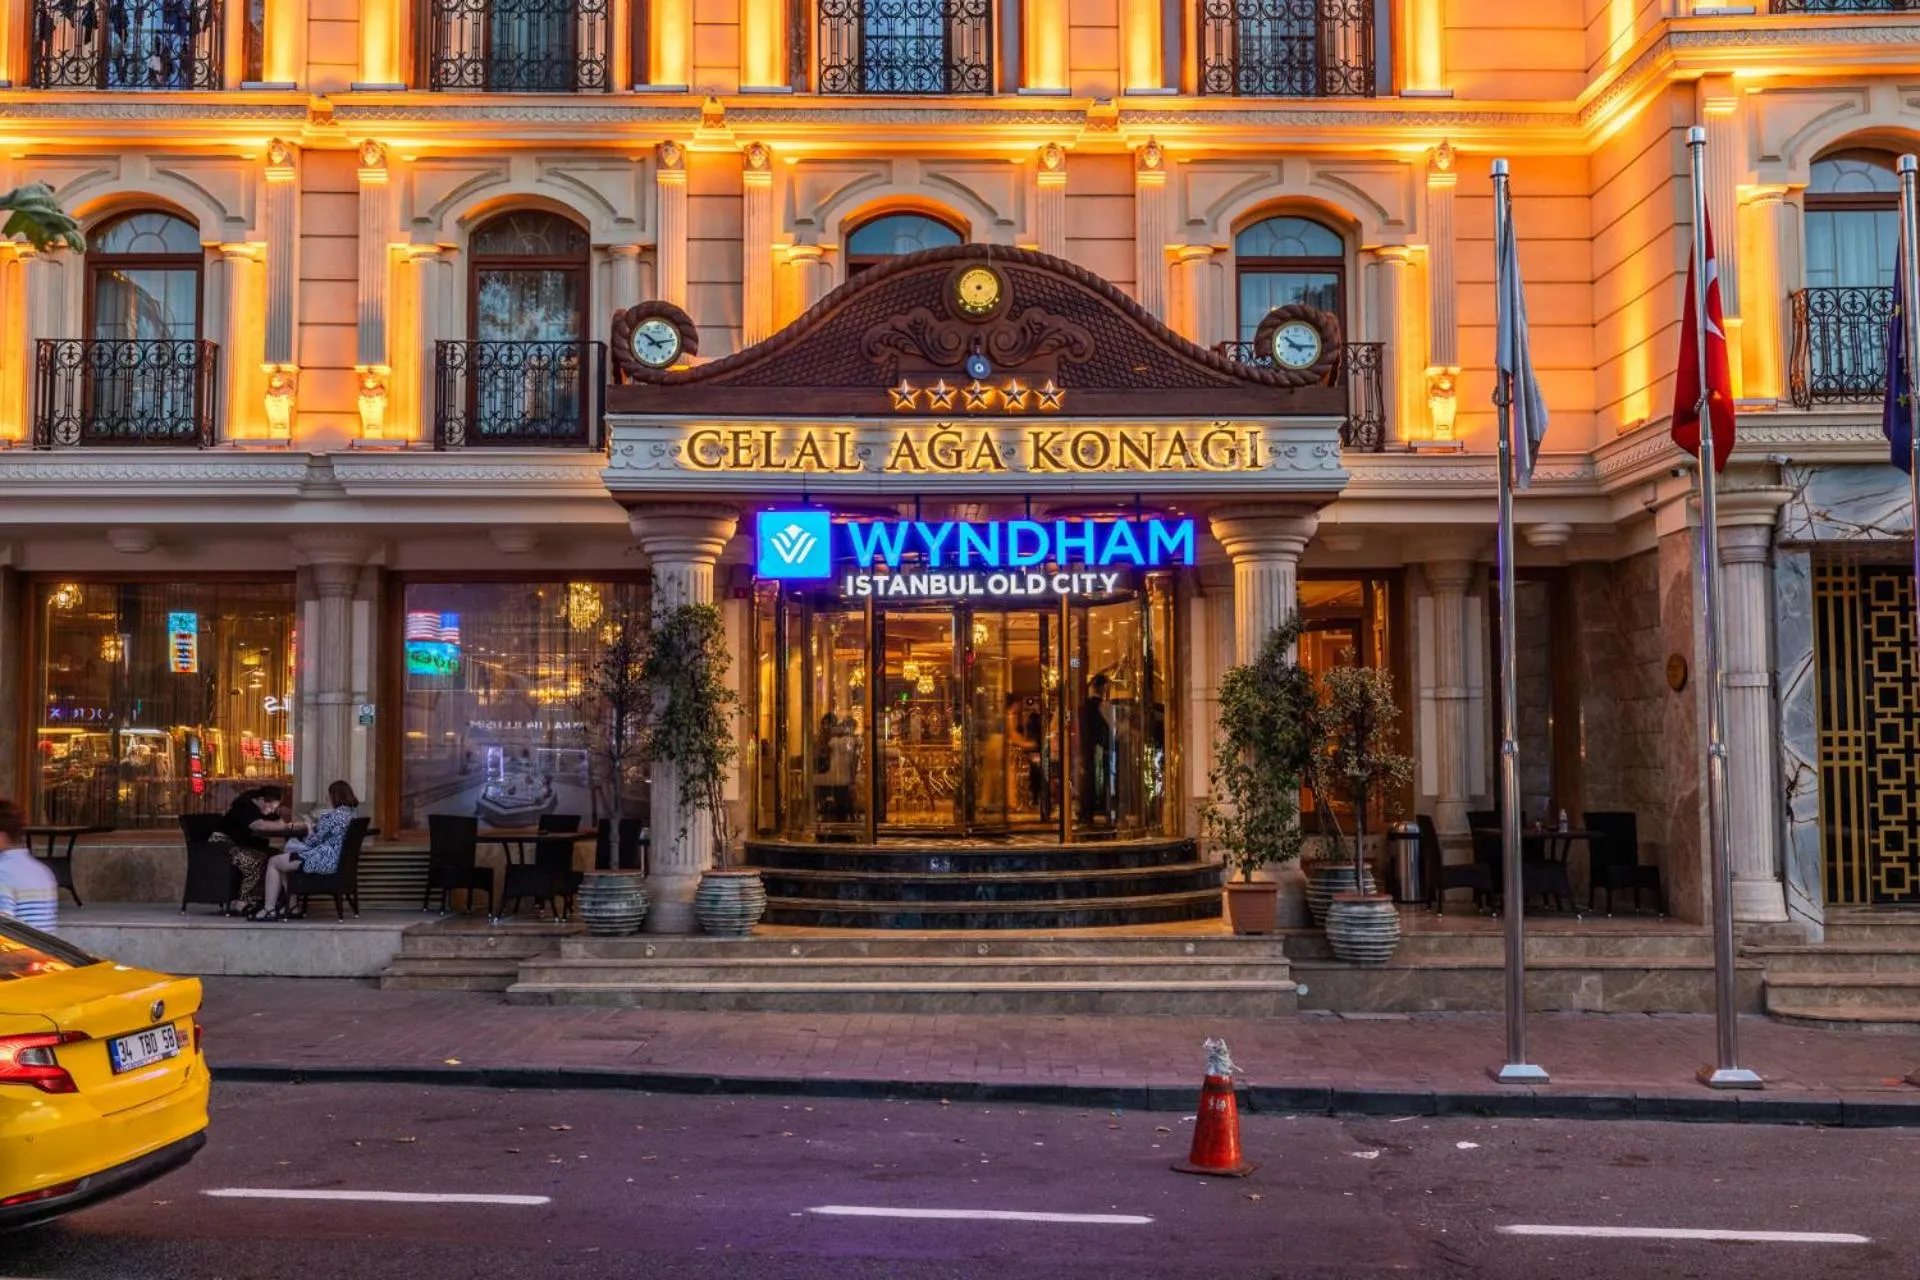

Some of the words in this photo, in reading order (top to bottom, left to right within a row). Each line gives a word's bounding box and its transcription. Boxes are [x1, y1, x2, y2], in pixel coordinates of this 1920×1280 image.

[687, 429, 862, 471] CELAL
[886, 422, 1006, 471] AĞA
[1028, 421, 1264, 471] KONAĞI
[847, 519, 1195, 567] WYNDHAM
[846, 574, 984, 596] ISTANBUL
[987, 573, 1047, 595] OLD
[1052, 572, 1119, 594] CITY
[118, 1040, 133, 1062] 34
[138, 1033, 158, 1056] TBD
[161, 1027, 175, 1049] 58
